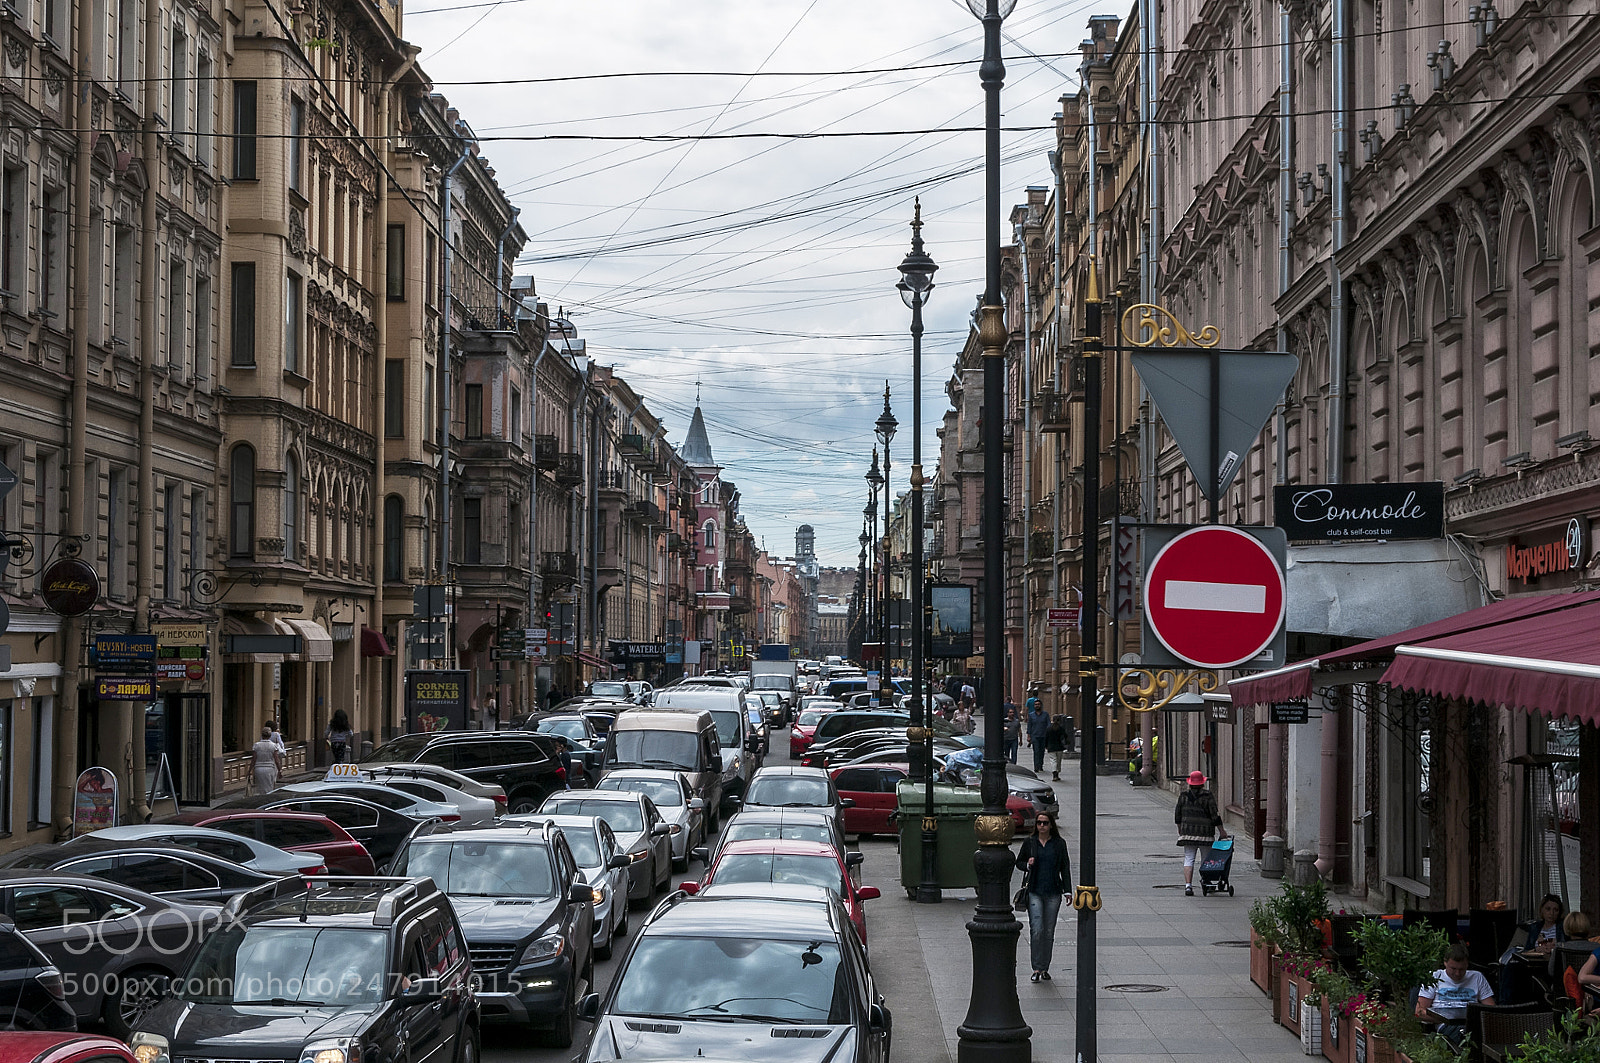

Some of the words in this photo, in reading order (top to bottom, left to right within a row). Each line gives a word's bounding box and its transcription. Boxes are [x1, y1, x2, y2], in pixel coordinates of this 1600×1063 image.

[1292, 488, 1427, 523] Commode
[1326, 528, 1342, 536] club
[1343, 528, 1349, 536] &
[1350, 527, 1380, 536] self-cost
[1380, 527, 1393, 535] bar
[1506, 537, 1570, 585] Марчелли
[167, 630, 205, 639] НЕВСКОМ
[416, 682, 459, 690] CORNER
[416, 690, 460, 699] KEBAB
[333, 764, 359, 776] 078
